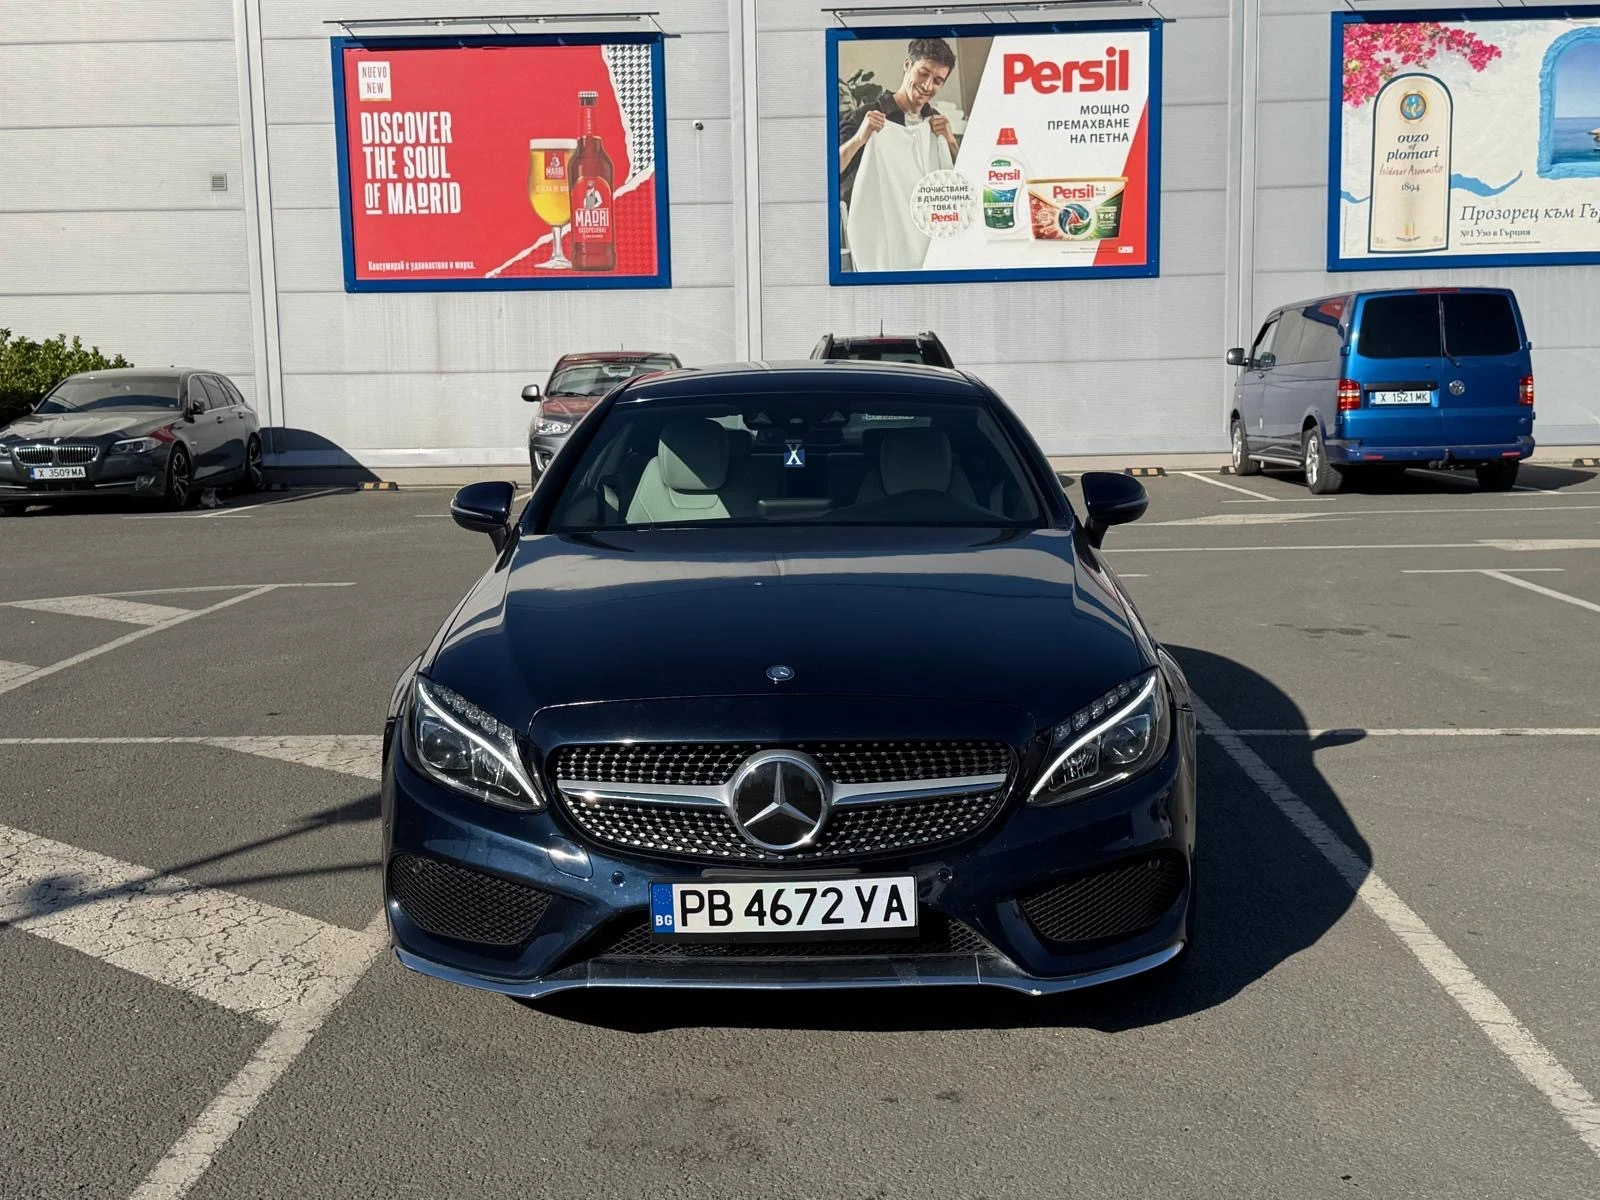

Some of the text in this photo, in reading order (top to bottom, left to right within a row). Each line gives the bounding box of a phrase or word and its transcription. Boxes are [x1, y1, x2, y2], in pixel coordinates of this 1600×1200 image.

[361, 66, 388, 78] NUEVO
[1003, 46, 1130, 95] Persil
[366, 82, 384, 94] NEW
[1080, 104, 1130, 116] МОЩНО
[360, 111, 452, 145] DISCOVER
[1047, 118, 1130, 131] ПРЕМАХВАНЕ
[1069, 132, 1130, 144] НА ПЕТНА
[1397, 133, 1429, 143] ouzo
[1386, 146, 1440, 163] plomari
[362, 146, 452, 179] THE SOUL
[988, 168, 1021, 181] Persil
[1052, 184, 1095, 199] Persil
[1401, 182, 1420, 192] 1894
[364, 182, 461, 215] OF MADRID
[931, 212, 959, 222] Persil
[1460, 203, 1600, 225] Прозорец към Гъ
[1392, 392, 1413, 402] 1521
[1415, 392, 1428, 402] MK
[48, 469, 70, 478] 3509
[71, 468, 84, 477] MA
[680, 884, 908, 927] PB 4672 YA
[655, 914, 673, 927] BG
